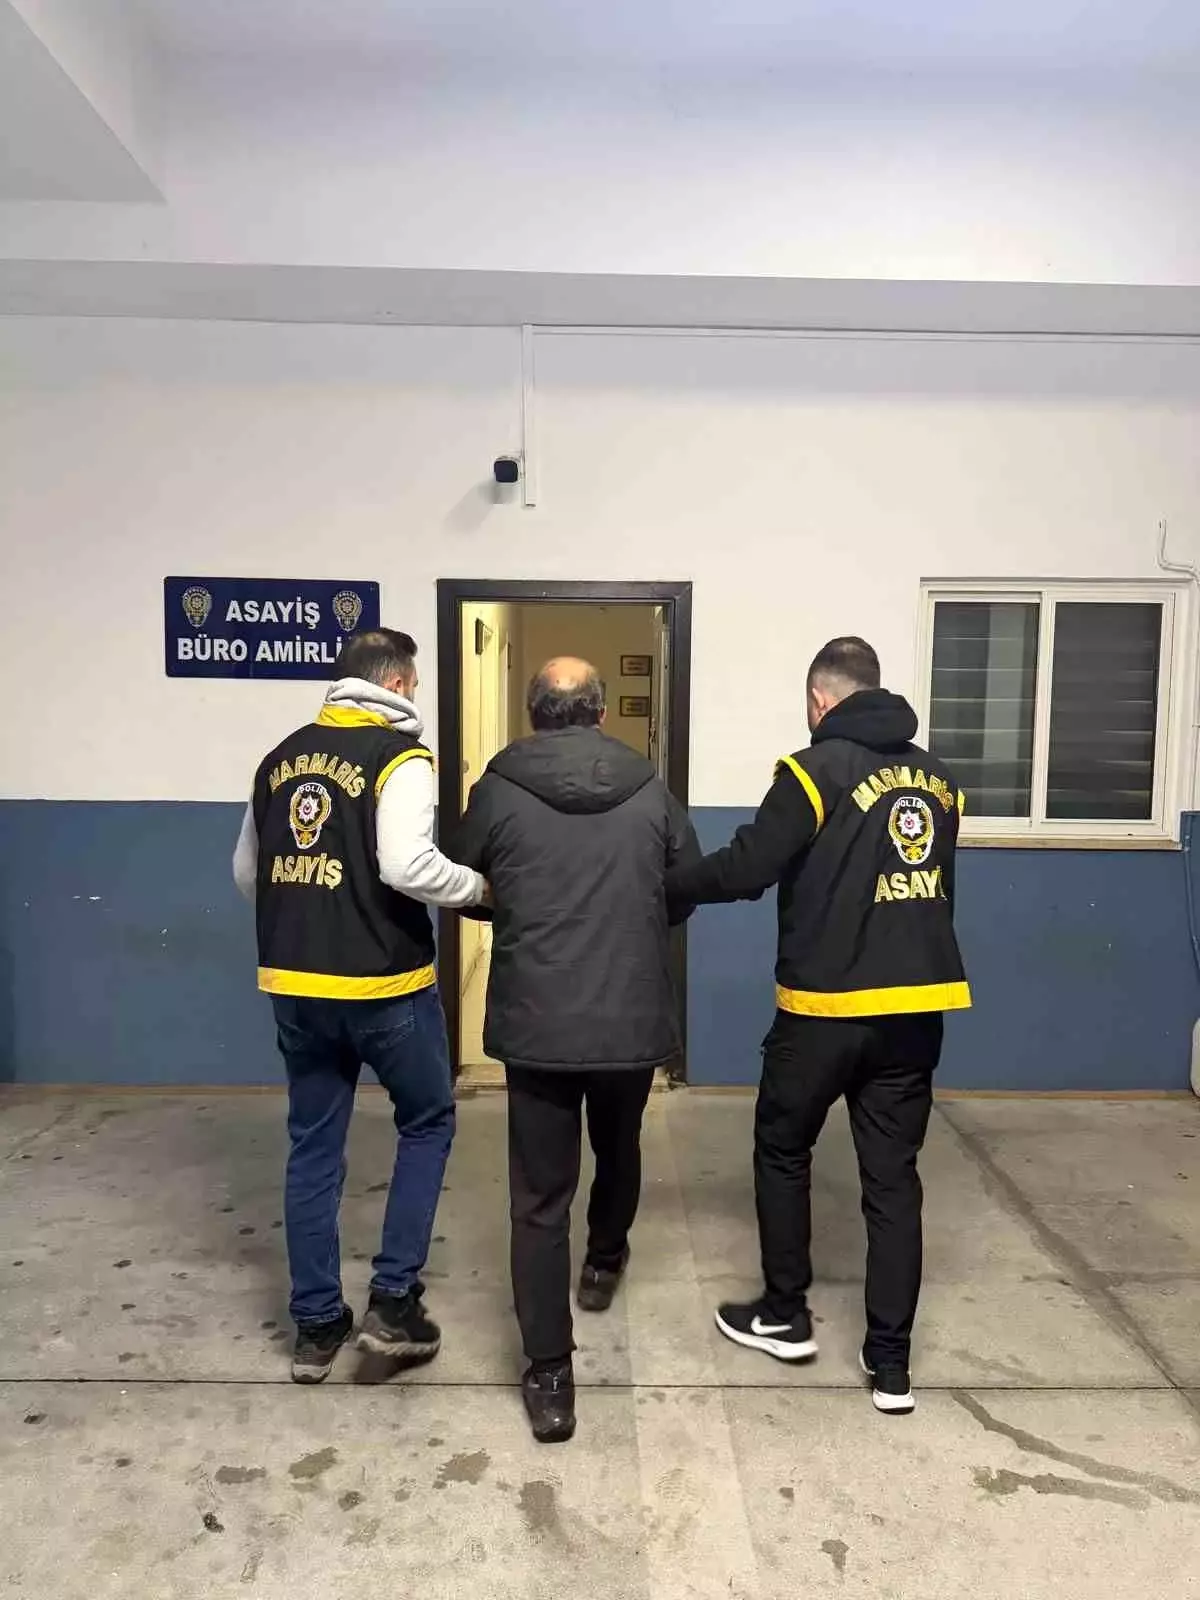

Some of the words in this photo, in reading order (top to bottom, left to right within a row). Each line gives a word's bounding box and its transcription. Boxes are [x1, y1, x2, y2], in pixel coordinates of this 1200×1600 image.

[225, 596, 320, 629] ASAYİŞ
[177, 634, 248, 662] BÜRO
[255, 635, 343, 664] AMİRLİ
[271, 852, 343, 890] ASAYİŞ
